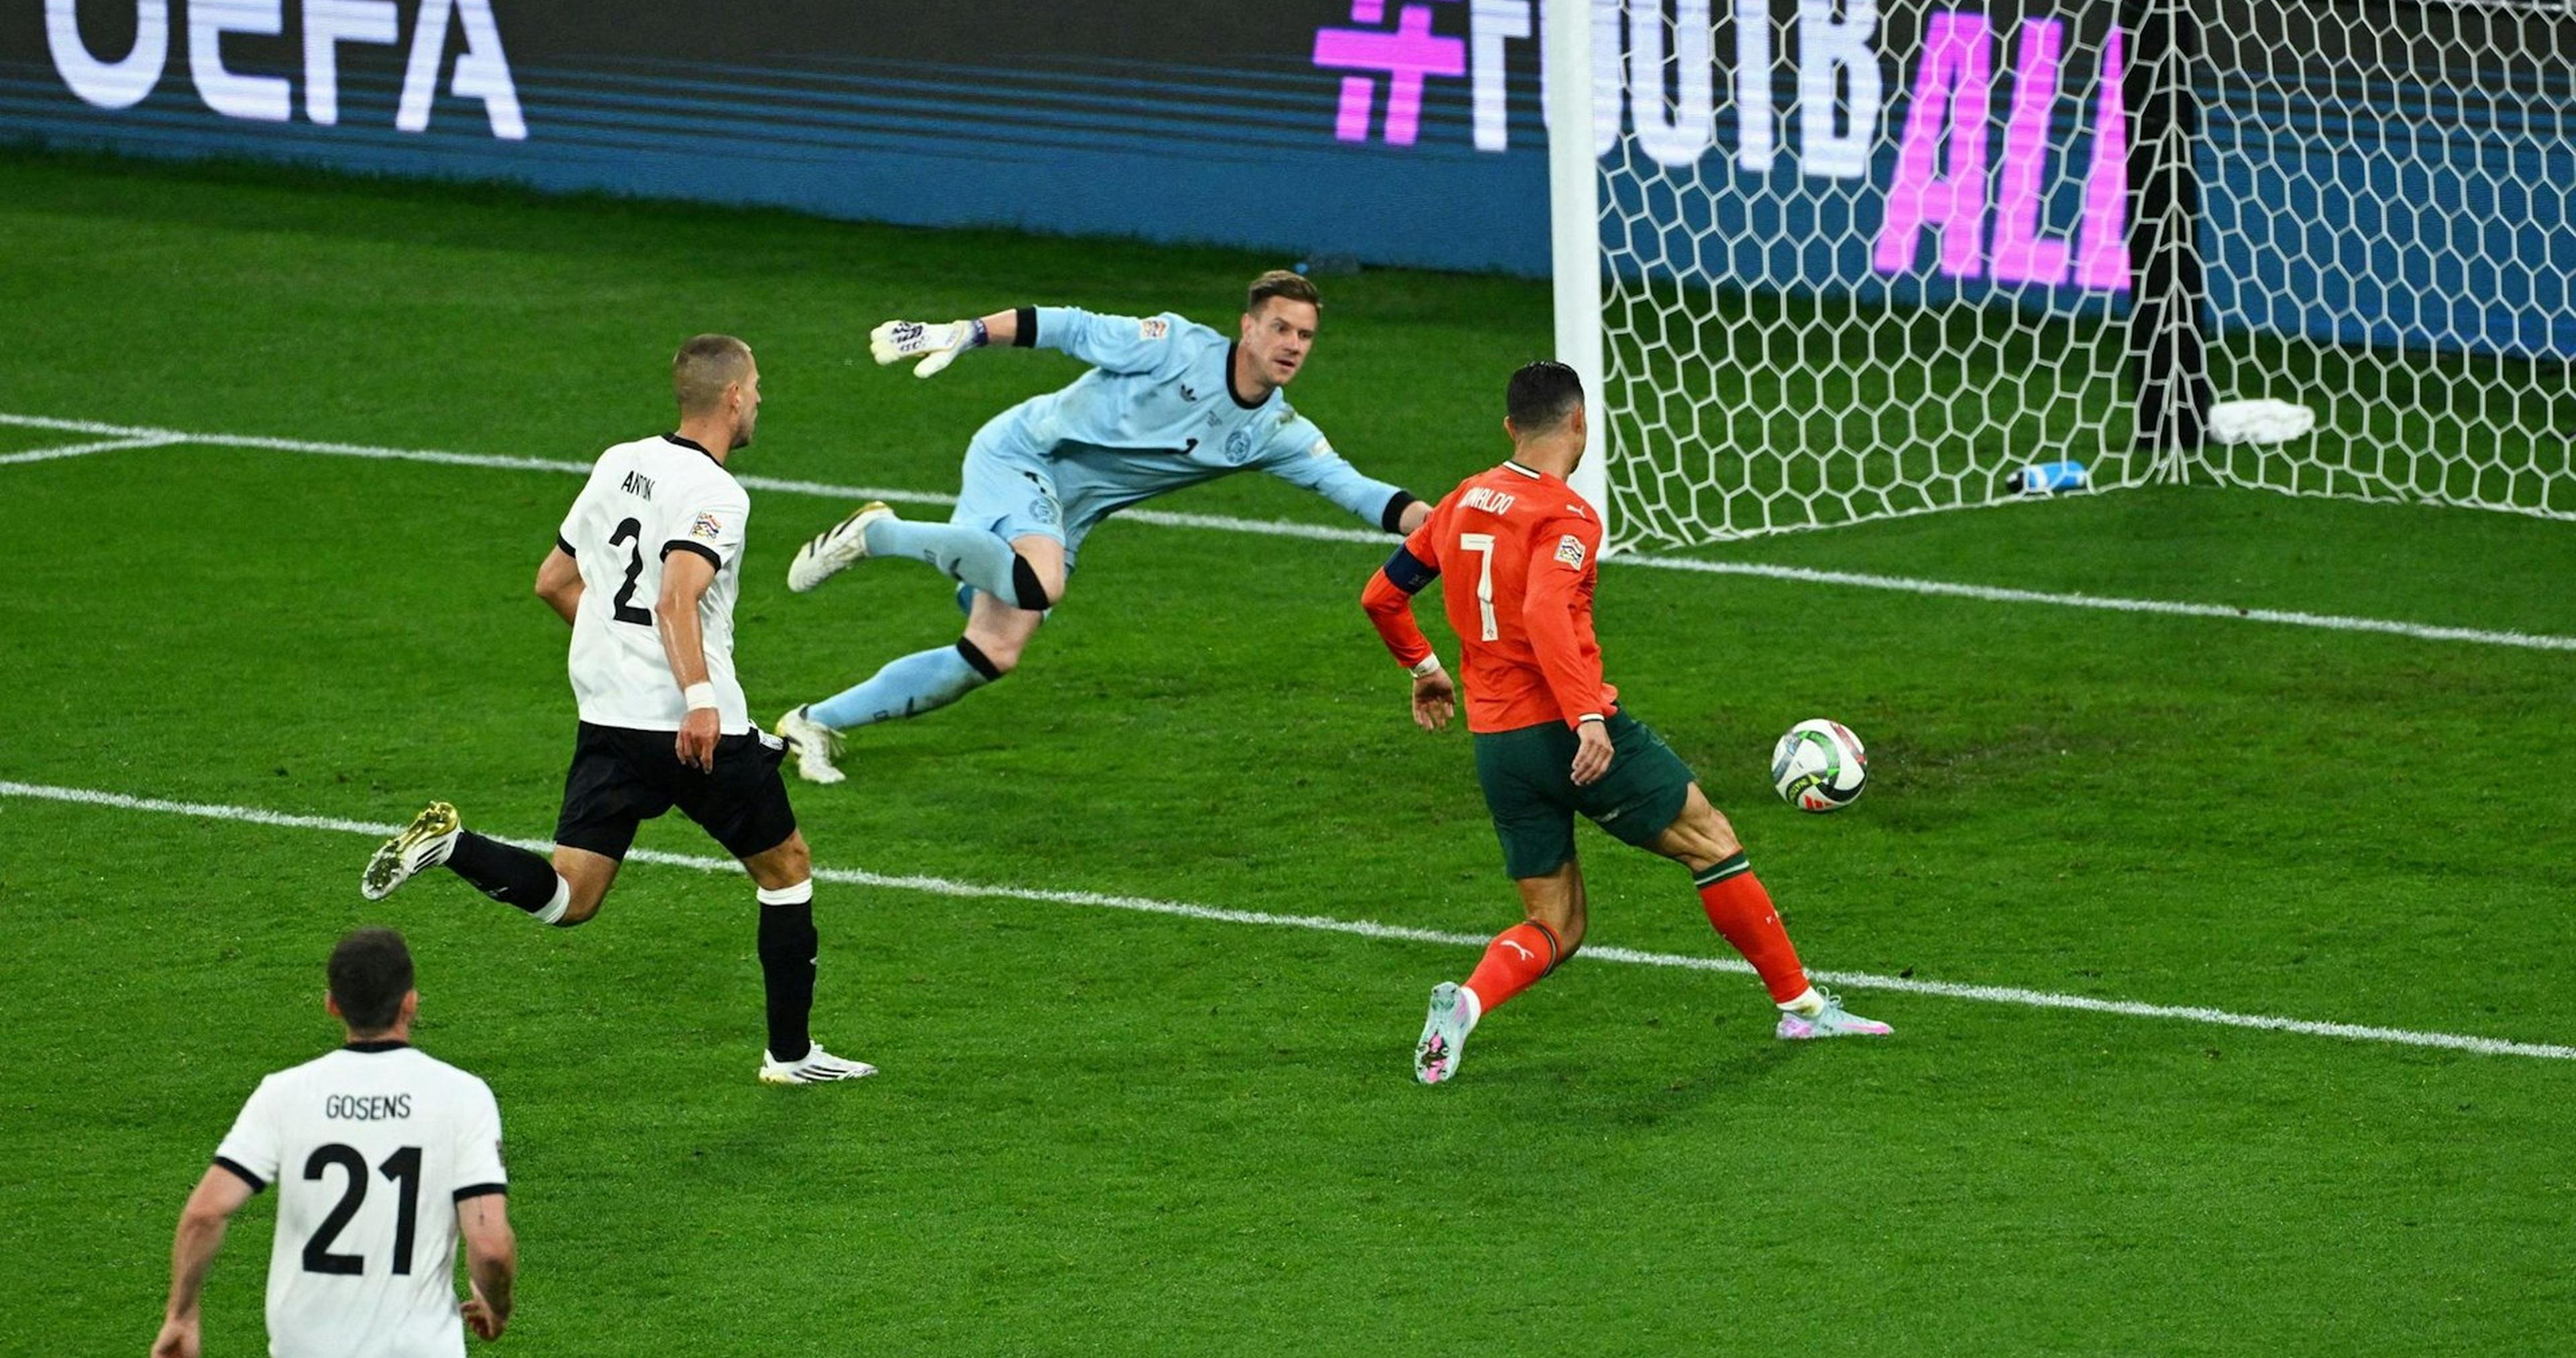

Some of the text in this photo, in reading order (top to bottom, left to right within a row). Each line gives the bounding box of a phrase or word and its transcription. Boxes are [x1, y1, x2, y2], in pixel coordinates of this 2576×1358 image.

[608, 517, 653, 627] 2
[1460, 533, 1499, 642] 7
[326, 1094, 411, 1120] GOSENS
[303, 1143, 423, 1275] 21
